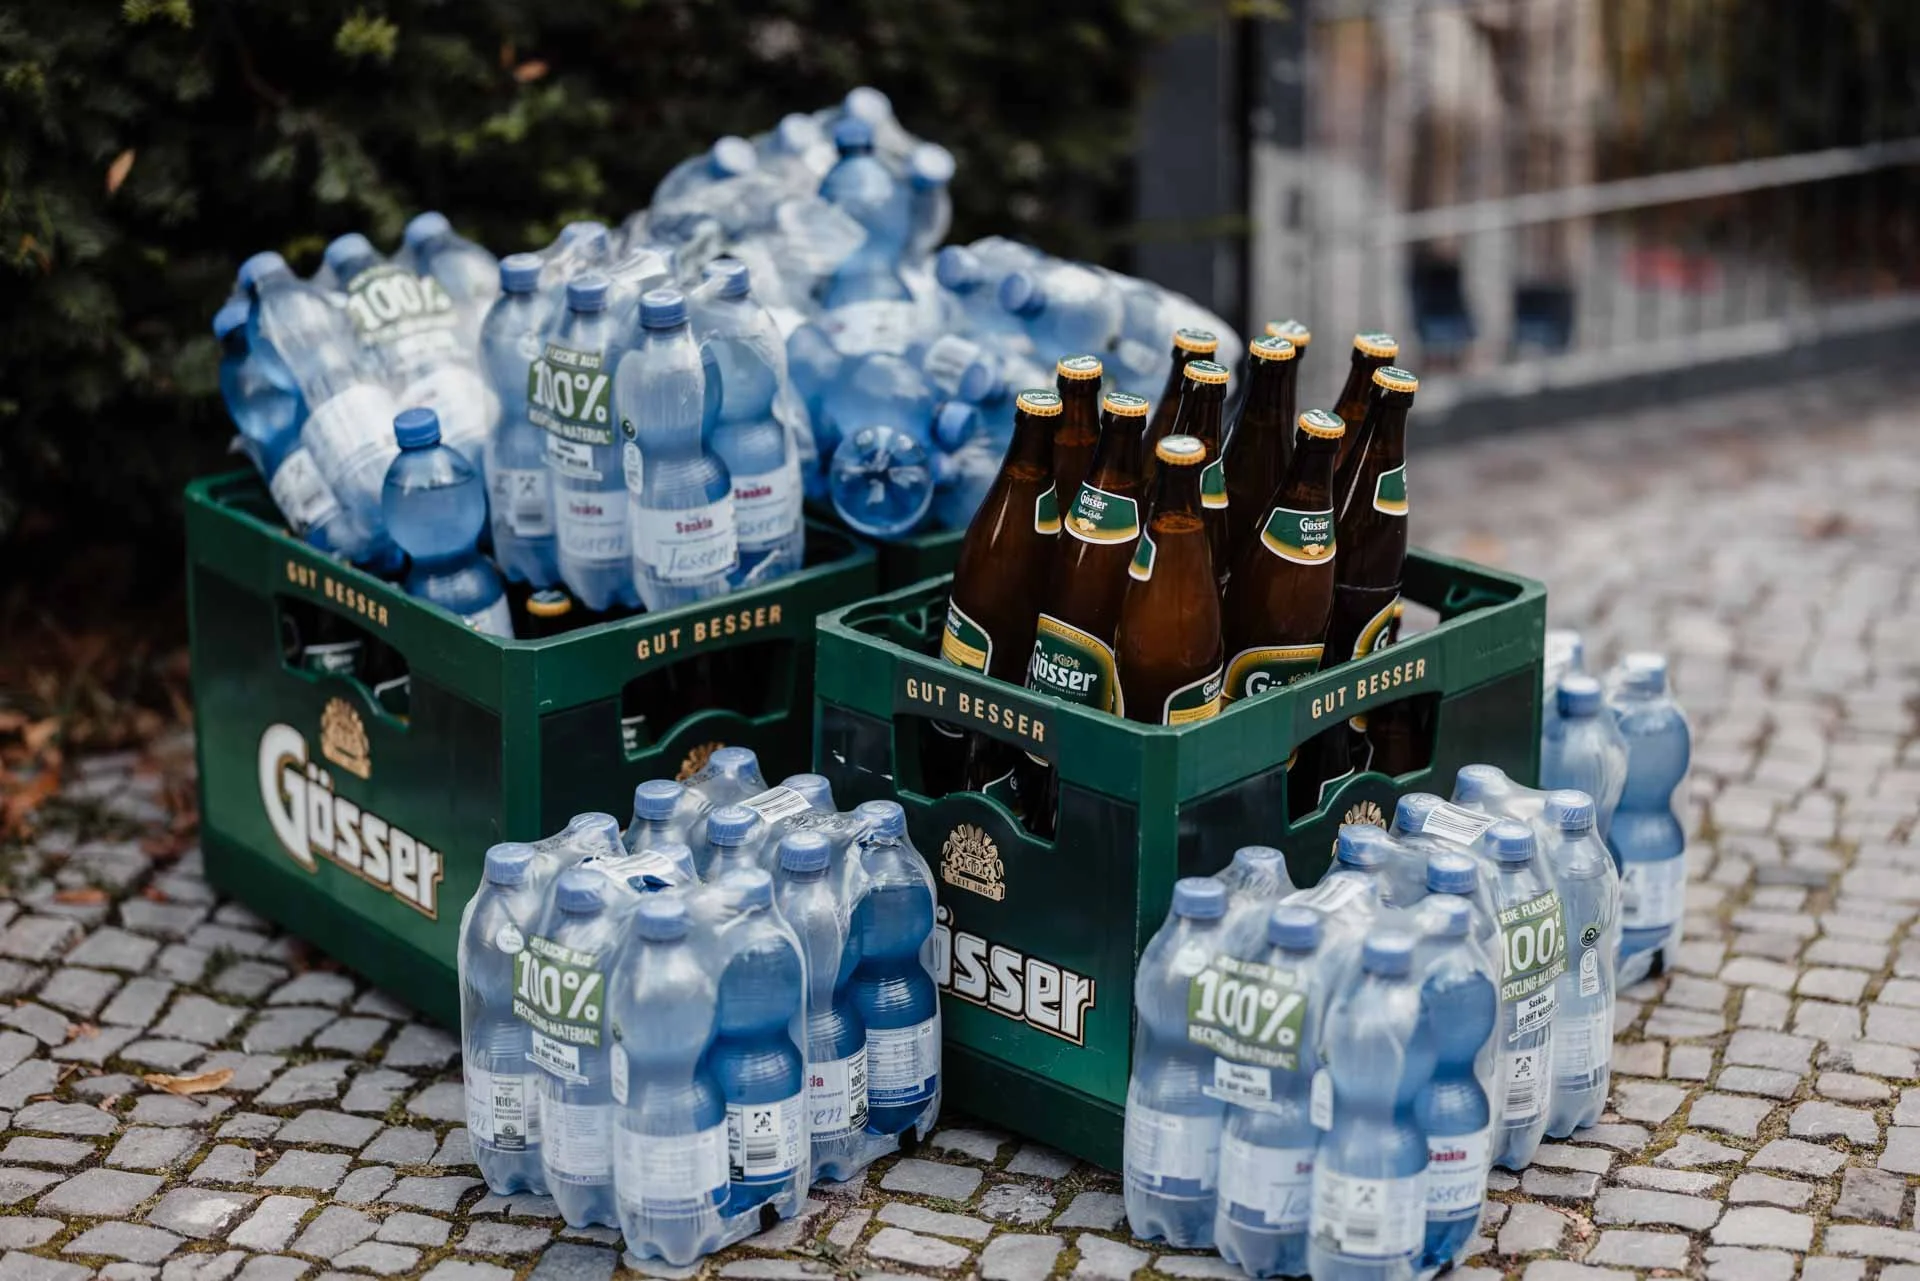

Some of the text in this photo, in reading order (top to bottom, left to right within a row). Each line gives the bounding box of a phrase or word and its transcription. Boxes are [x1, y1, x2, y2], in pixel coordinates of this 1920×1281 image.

[1300, 517, 1330, 532] Gösser
[286, 560, 388, 628] GUT BESSER
[637, 604, 782, 660] GUT BESSER
[1033, 639, 1098, 692] Gösser
[1311, 658, 1426, 719] GUT BESSER
[906, 678, 1045, 743] GUT BESSER
[259, 723, 443, 920] Gösser
[518, 950, 602, 1021] 100%
[936, 905, 1097, 1046] össer
[1195, 968, 1303, 1046] 100%
